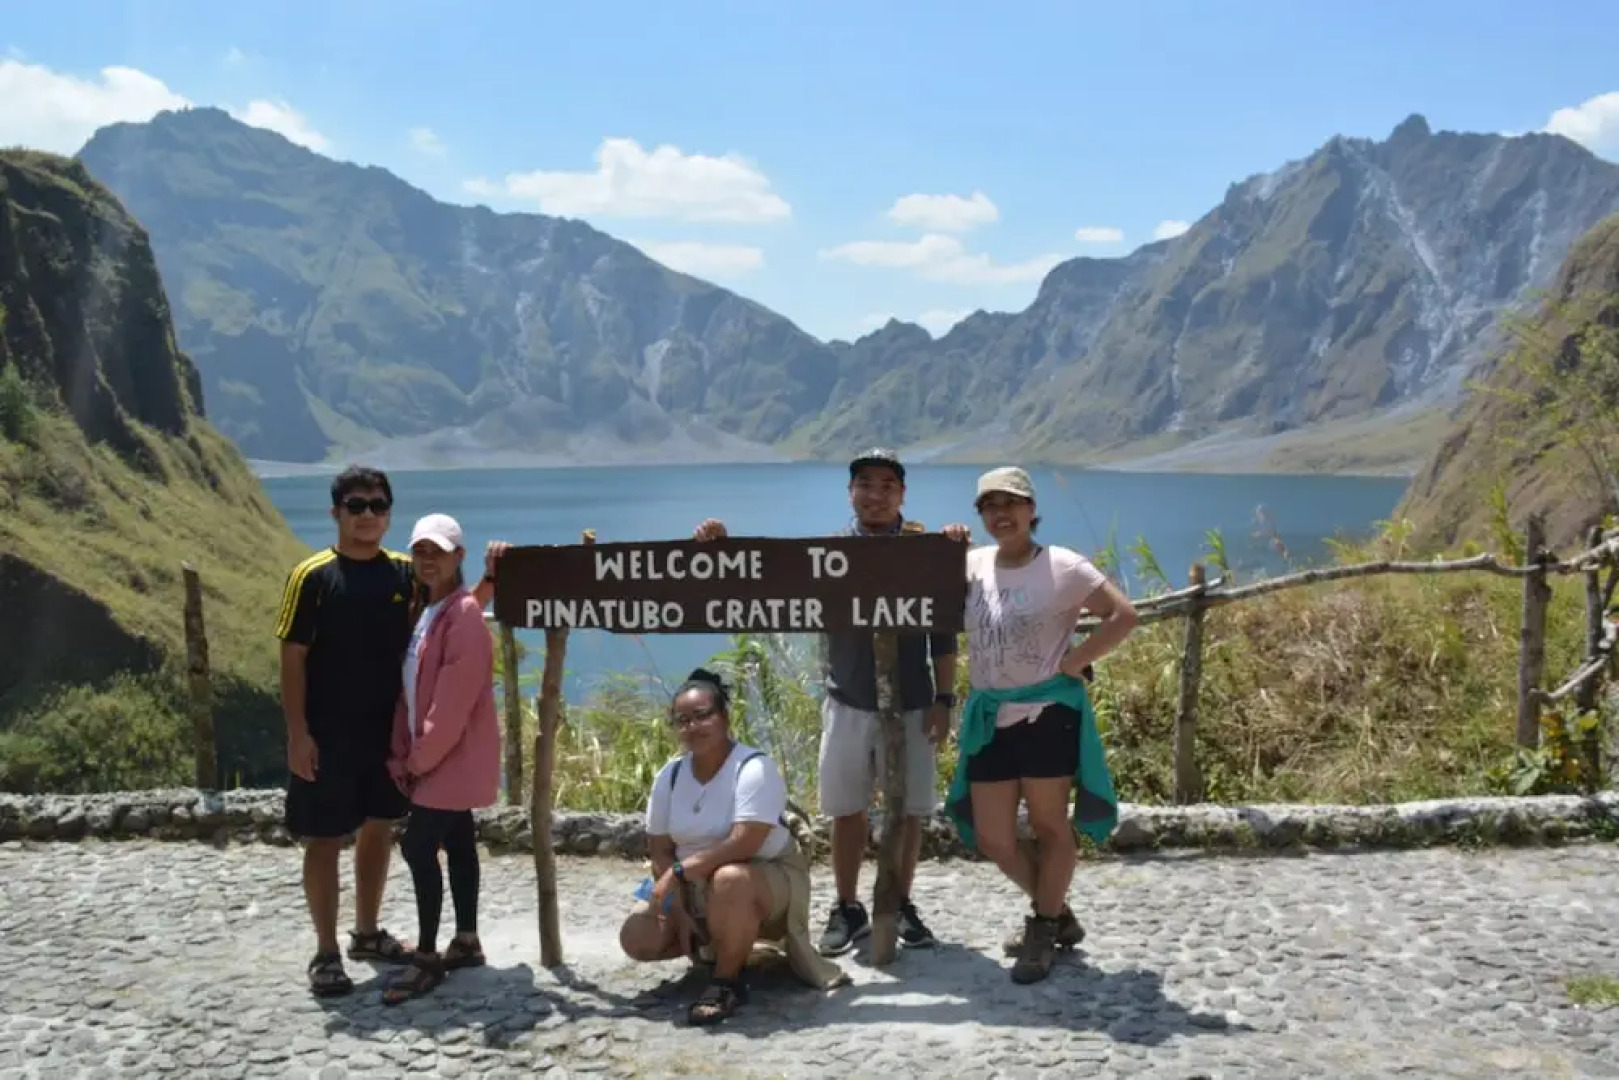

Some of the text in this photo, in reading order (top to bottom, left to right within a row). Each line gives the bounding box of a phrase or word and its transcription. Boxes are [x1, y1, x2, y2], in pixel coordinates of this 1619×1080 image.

[596, 547, 849, 580] WELCOME TO
[526, 597, 934, 629] PINATUBO CRATER LAKE
